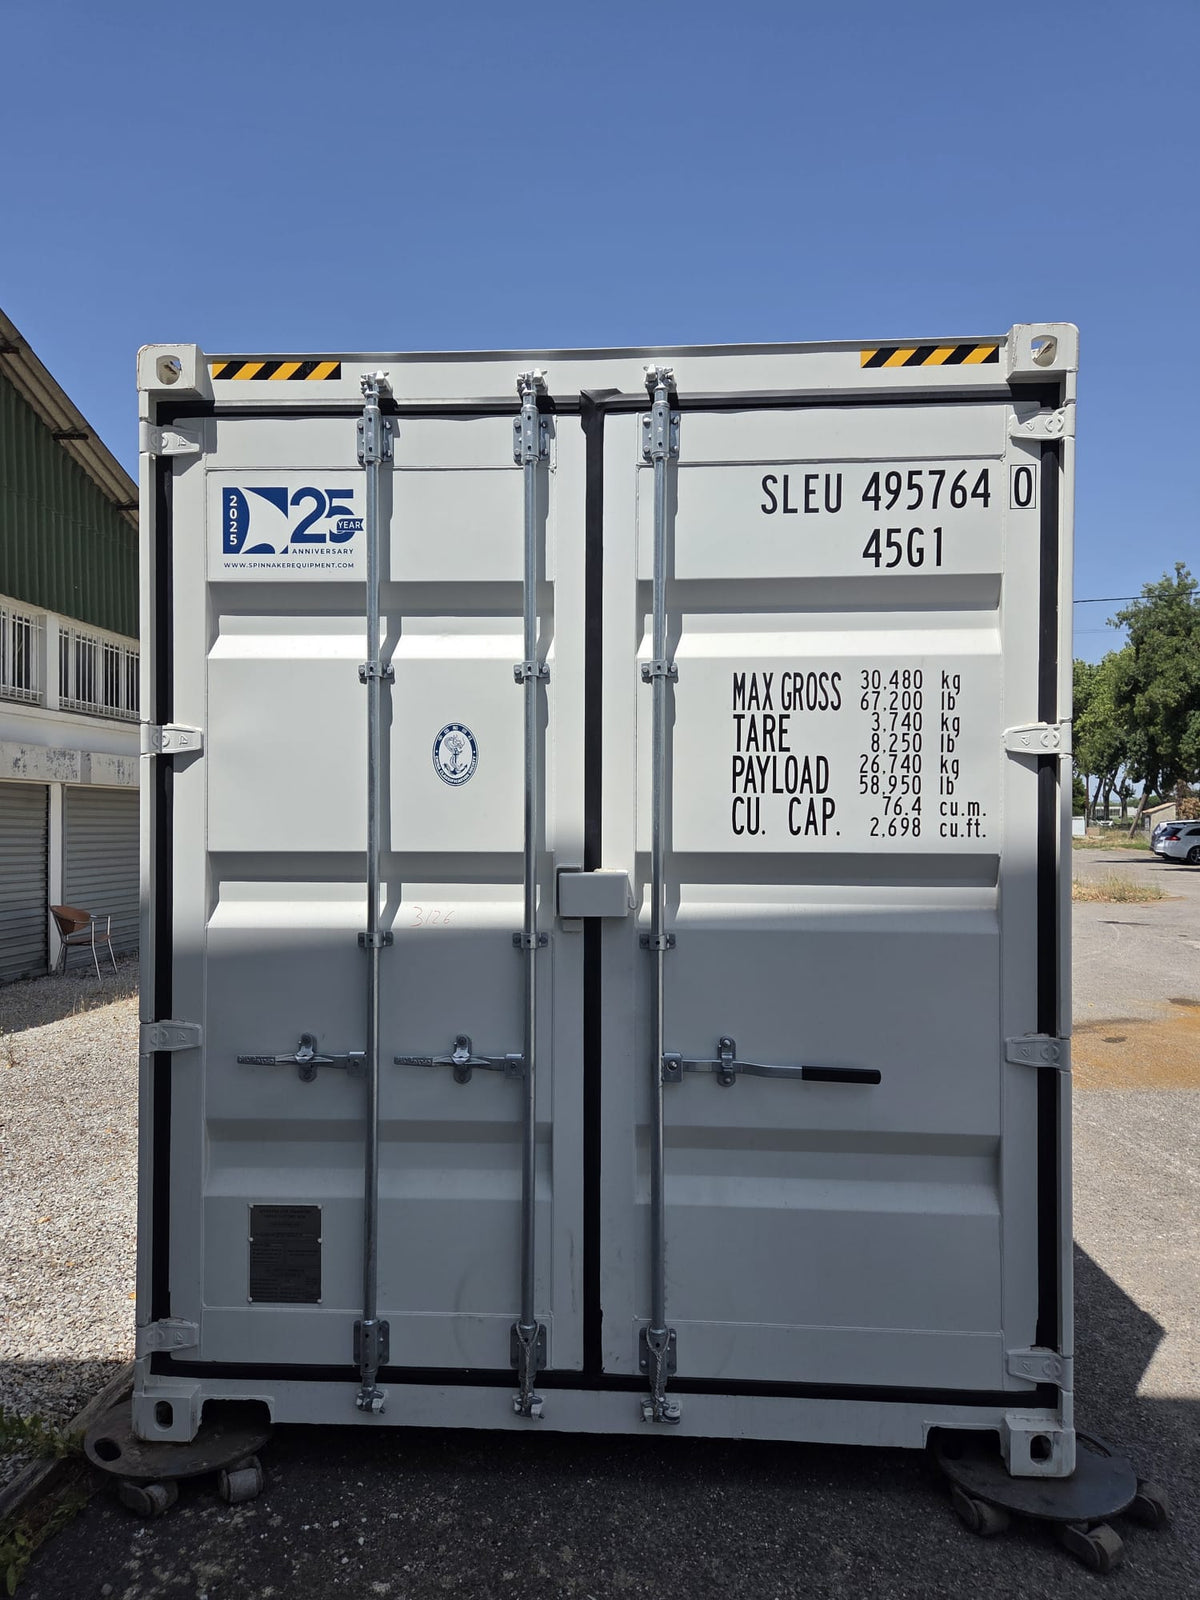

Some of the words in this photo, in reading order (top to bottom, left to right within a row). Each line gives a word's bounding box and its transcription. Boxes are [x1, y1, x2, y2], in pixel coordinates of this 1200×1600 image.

[761, 473, 842, 514] SLEU
[862, 468, 991, 511] 495764
[1014, 467, 1032, 507] 0
[229, 495, 238, 545] 2025
[290, 487, 355, 543] 25
[338, 520, 362, 530] YEAR
[862, 527, 942, 567] 45G1
[733, 672, 774, 711] MAX
[781, 672, 842, 711] GROSS
[860, 669, 923, 690] 30,480
[941, 670, 961, 695] kg
[860, 691, 923, 712] 67,200
[941, 691, 956, 711] lb
[733, 714, 791, 752] TARE
[871, 712, 922, 733] 3,740
[940, 712, 961, 738] kg
[871, 733, 922, 754] 8,250
[940, 734, 955, 753] lb
[732, 755, 829, 794] PAYLOAD
[859, 754, 922, 775] 26,740
[940, 755, 960, 780] kg
[940, 776, 954, 795] lb
[732, 796, 766, 836] CU.
[788, 797, 841, 836] CAP.
[882, 796, 922, 816] 76.4
[870, 817, 921, 838] 2,698
